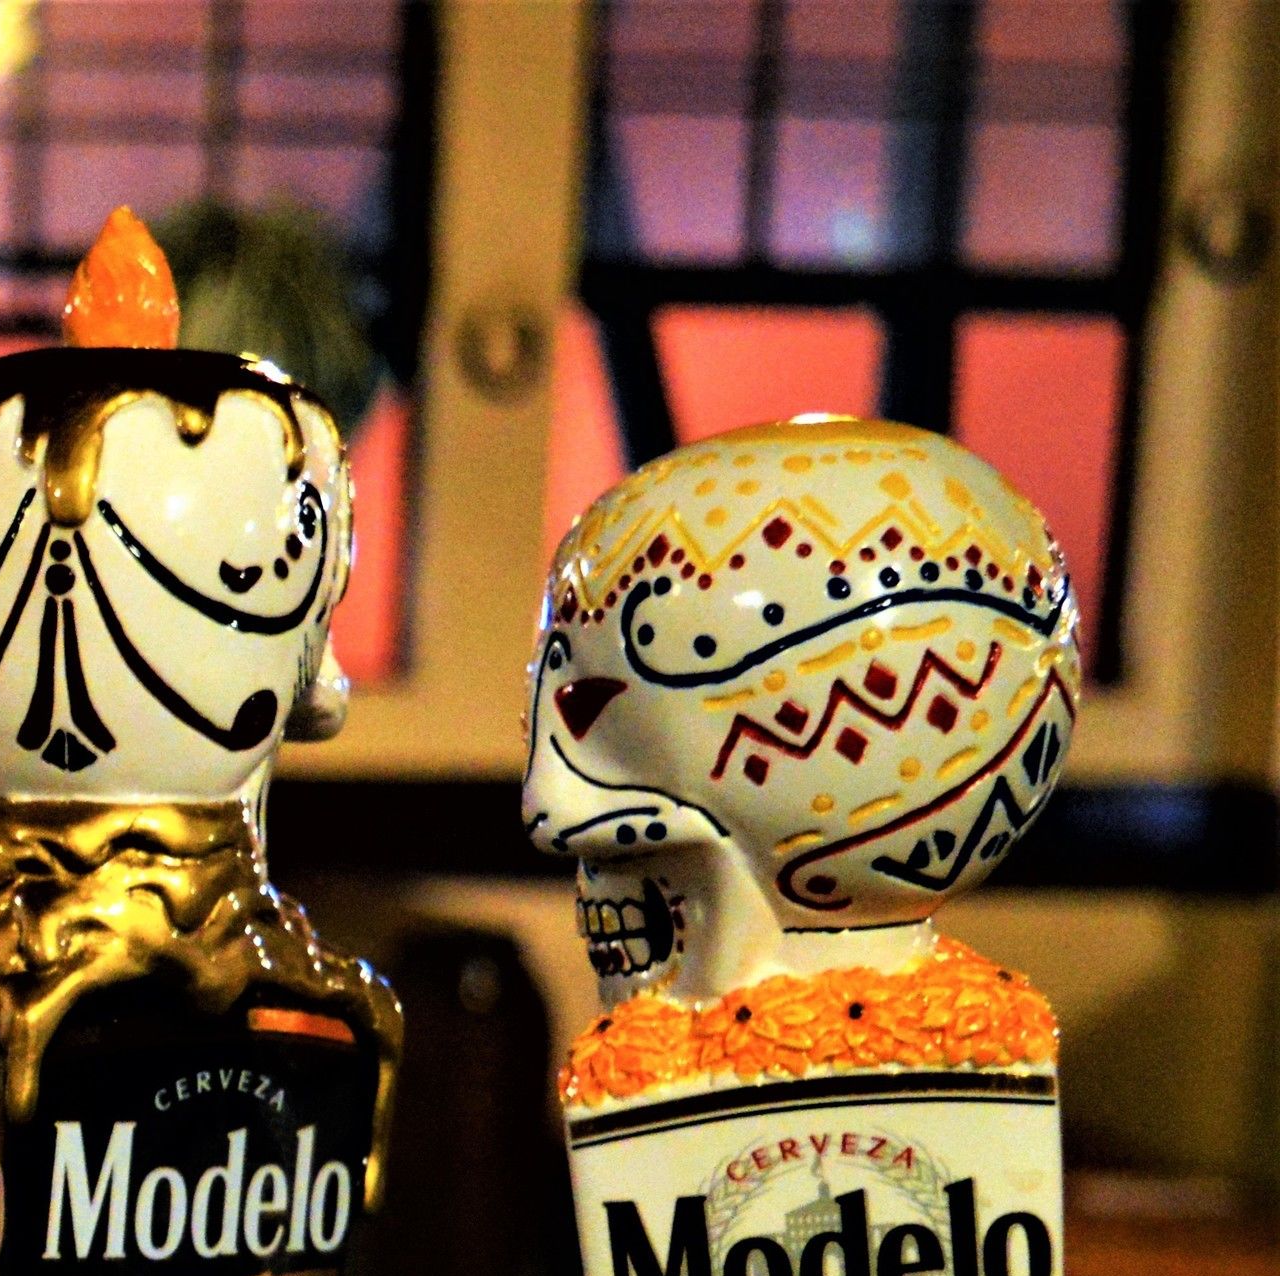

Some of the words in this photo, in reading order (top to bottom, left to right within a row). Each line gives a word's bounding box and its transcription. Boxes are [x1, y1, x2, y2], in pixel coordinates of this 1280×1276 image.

[153, 1068, 286, 1113] CERVEZA
[726, 1132, 918, 1184] CERVEZA
[42, 1120, 352, 1261] Modelo
